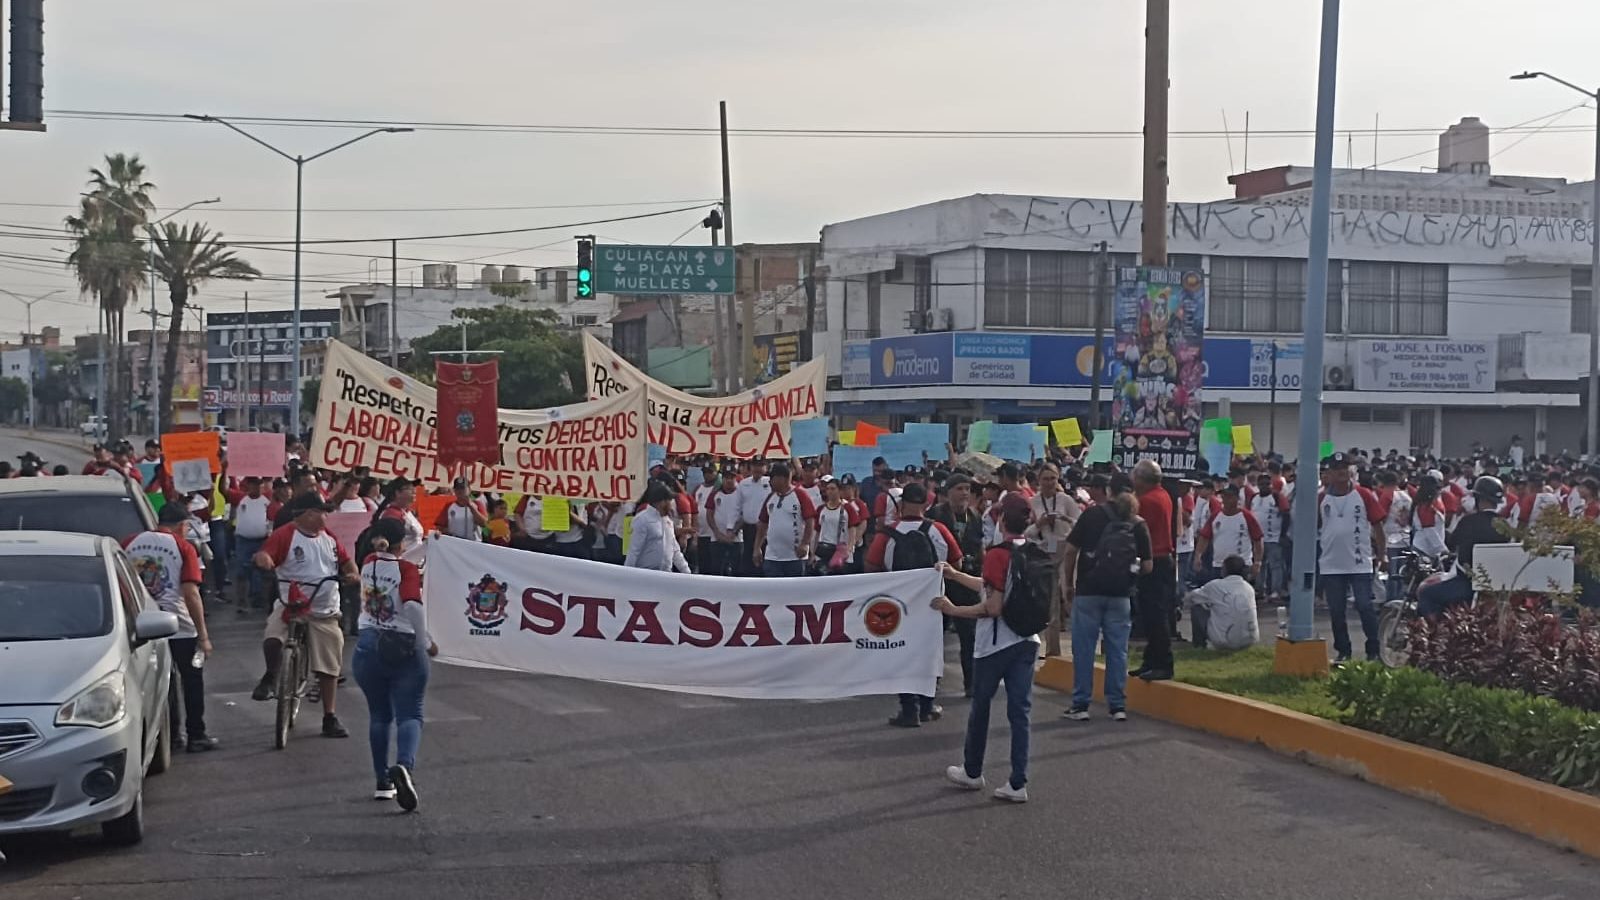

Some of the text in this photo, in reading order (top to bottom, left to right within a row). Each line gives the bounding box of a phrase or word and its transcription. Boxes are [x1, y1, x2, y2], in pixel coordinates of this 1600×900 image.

[605, 250, 688, 262] CULIACAN
[639, 263, 705, 276] PLAYAS
[615, 277, 691, 290] MUELLES
[969, 371, 1015, 379] de Calidad
[659, 403, 670, 422] a
[673, 406, 692, 426] la
[697, 383, 818, 429] AUTONOMIA
[545, 411, 638, 445] DERECHOS
[517, 444, 627, 472] CONTRATO
[480, 466, 515, 491] DE
[1353, 505, 1364, 565] STASAM
[520, 586, 855, 648] STASAM
[855, 637, 905, 650] Sinaloa
